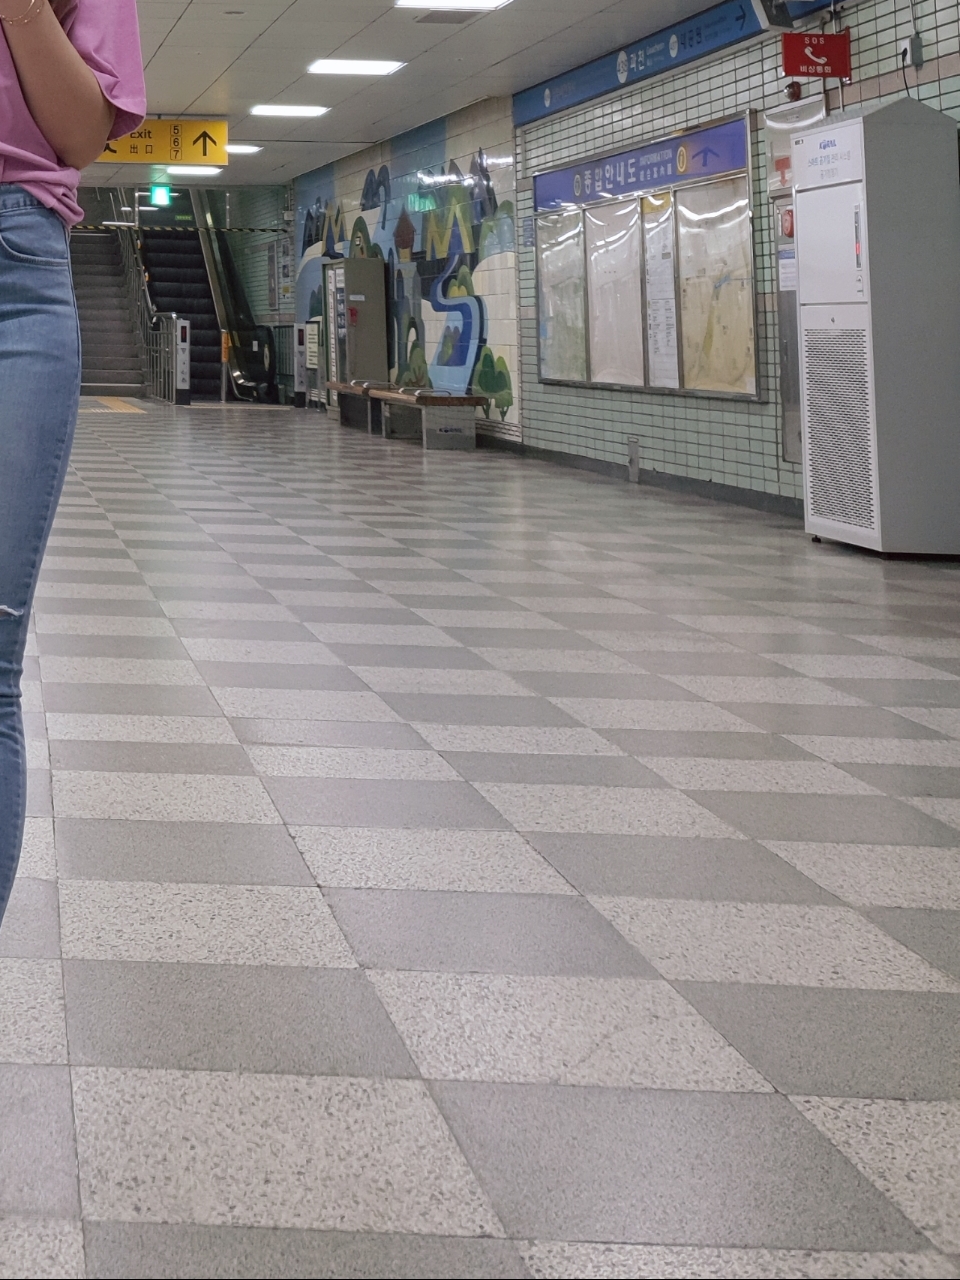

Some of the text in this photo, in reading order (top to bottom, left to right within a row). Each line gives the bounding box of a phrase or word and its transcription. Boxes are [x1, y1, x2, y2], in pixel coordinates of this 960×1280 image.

[804, 36, 825, 44] SOS
[799, 65, 832, 74] 비상통화
[172, 124, 180, 135] 5
[172, 137, 180, 147] 6
[129, 144, 153, 155] 出口
[172, 149, 180, 160] 7
[583, 158, 637, 195] 종합안내도
